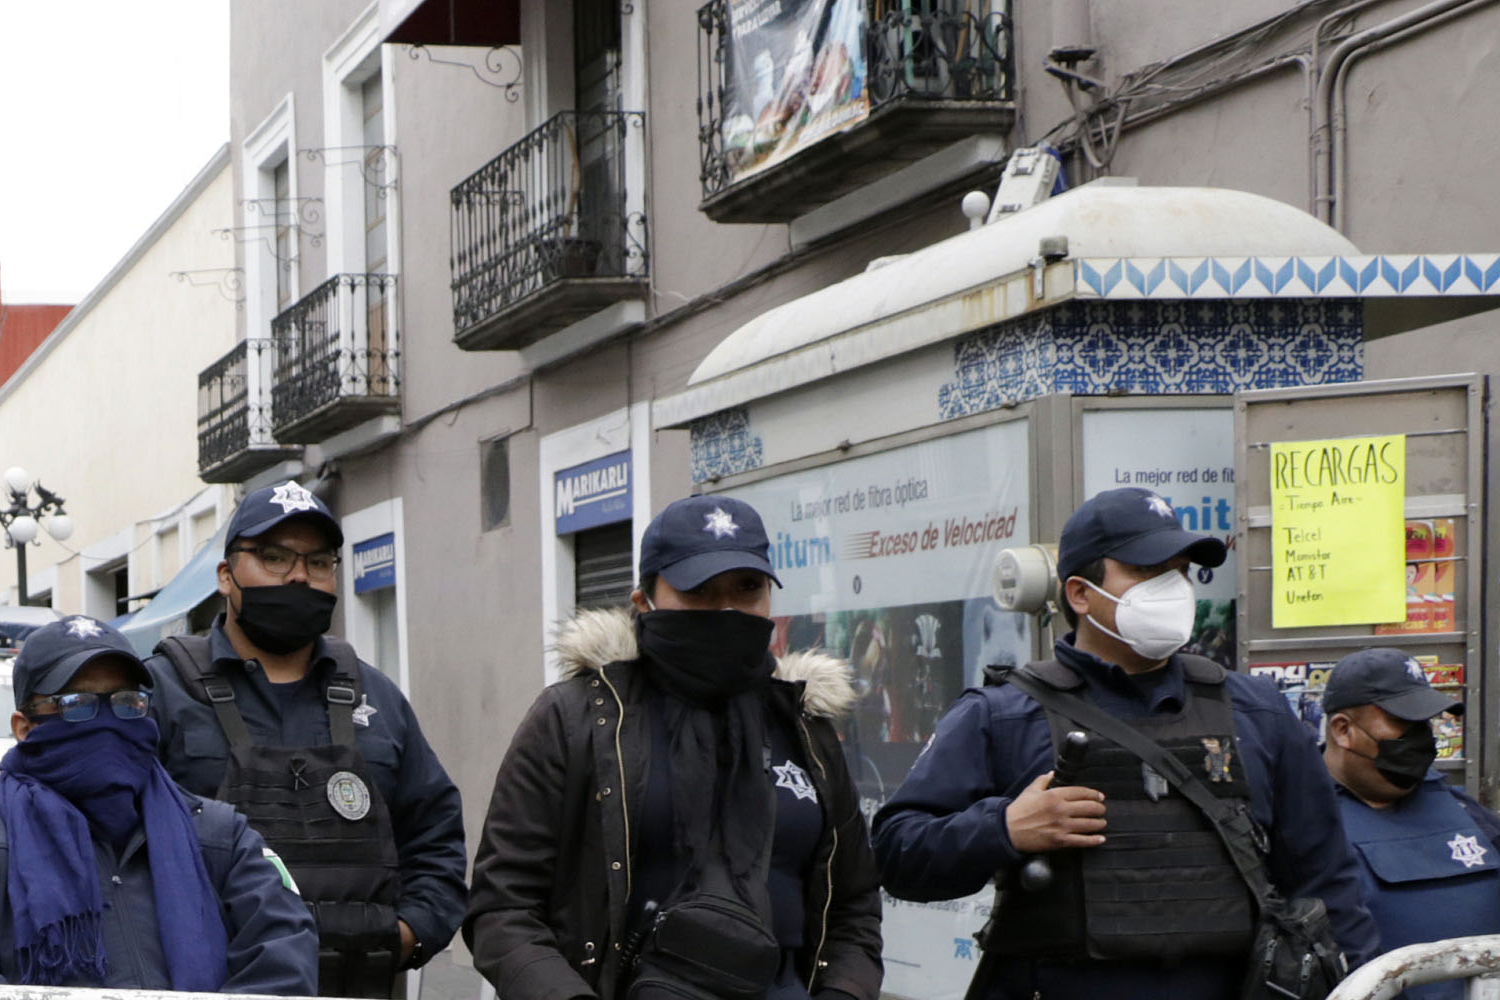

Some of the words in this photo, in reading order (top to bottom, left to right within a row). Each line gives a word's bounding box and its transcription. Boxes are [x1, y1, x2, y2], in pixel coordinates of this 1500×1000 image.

[1115, 468, 1131, 484] La
[1135, 468, 1172, 487] mejor
[1176, 467, 1198, 483] red
[1202, 467, 1218, 483] de
[1275, 441, 1398, 490] RECARGAS
[556, 462, 628, 518] MARIKARLI
[791, 501, 802, 522] La
[802, 498, 831, 522] mejor
[834, 493, 850, 513] red
[853, 490, 867, 511] de
[868, 485, 892, 508] fibra
[895, 478, 928, 505] óptica
[868, 530, 915, 558] Exceso
[921, 522, 939, 551] de
[1283, 526, 1322, 544] Telcel
